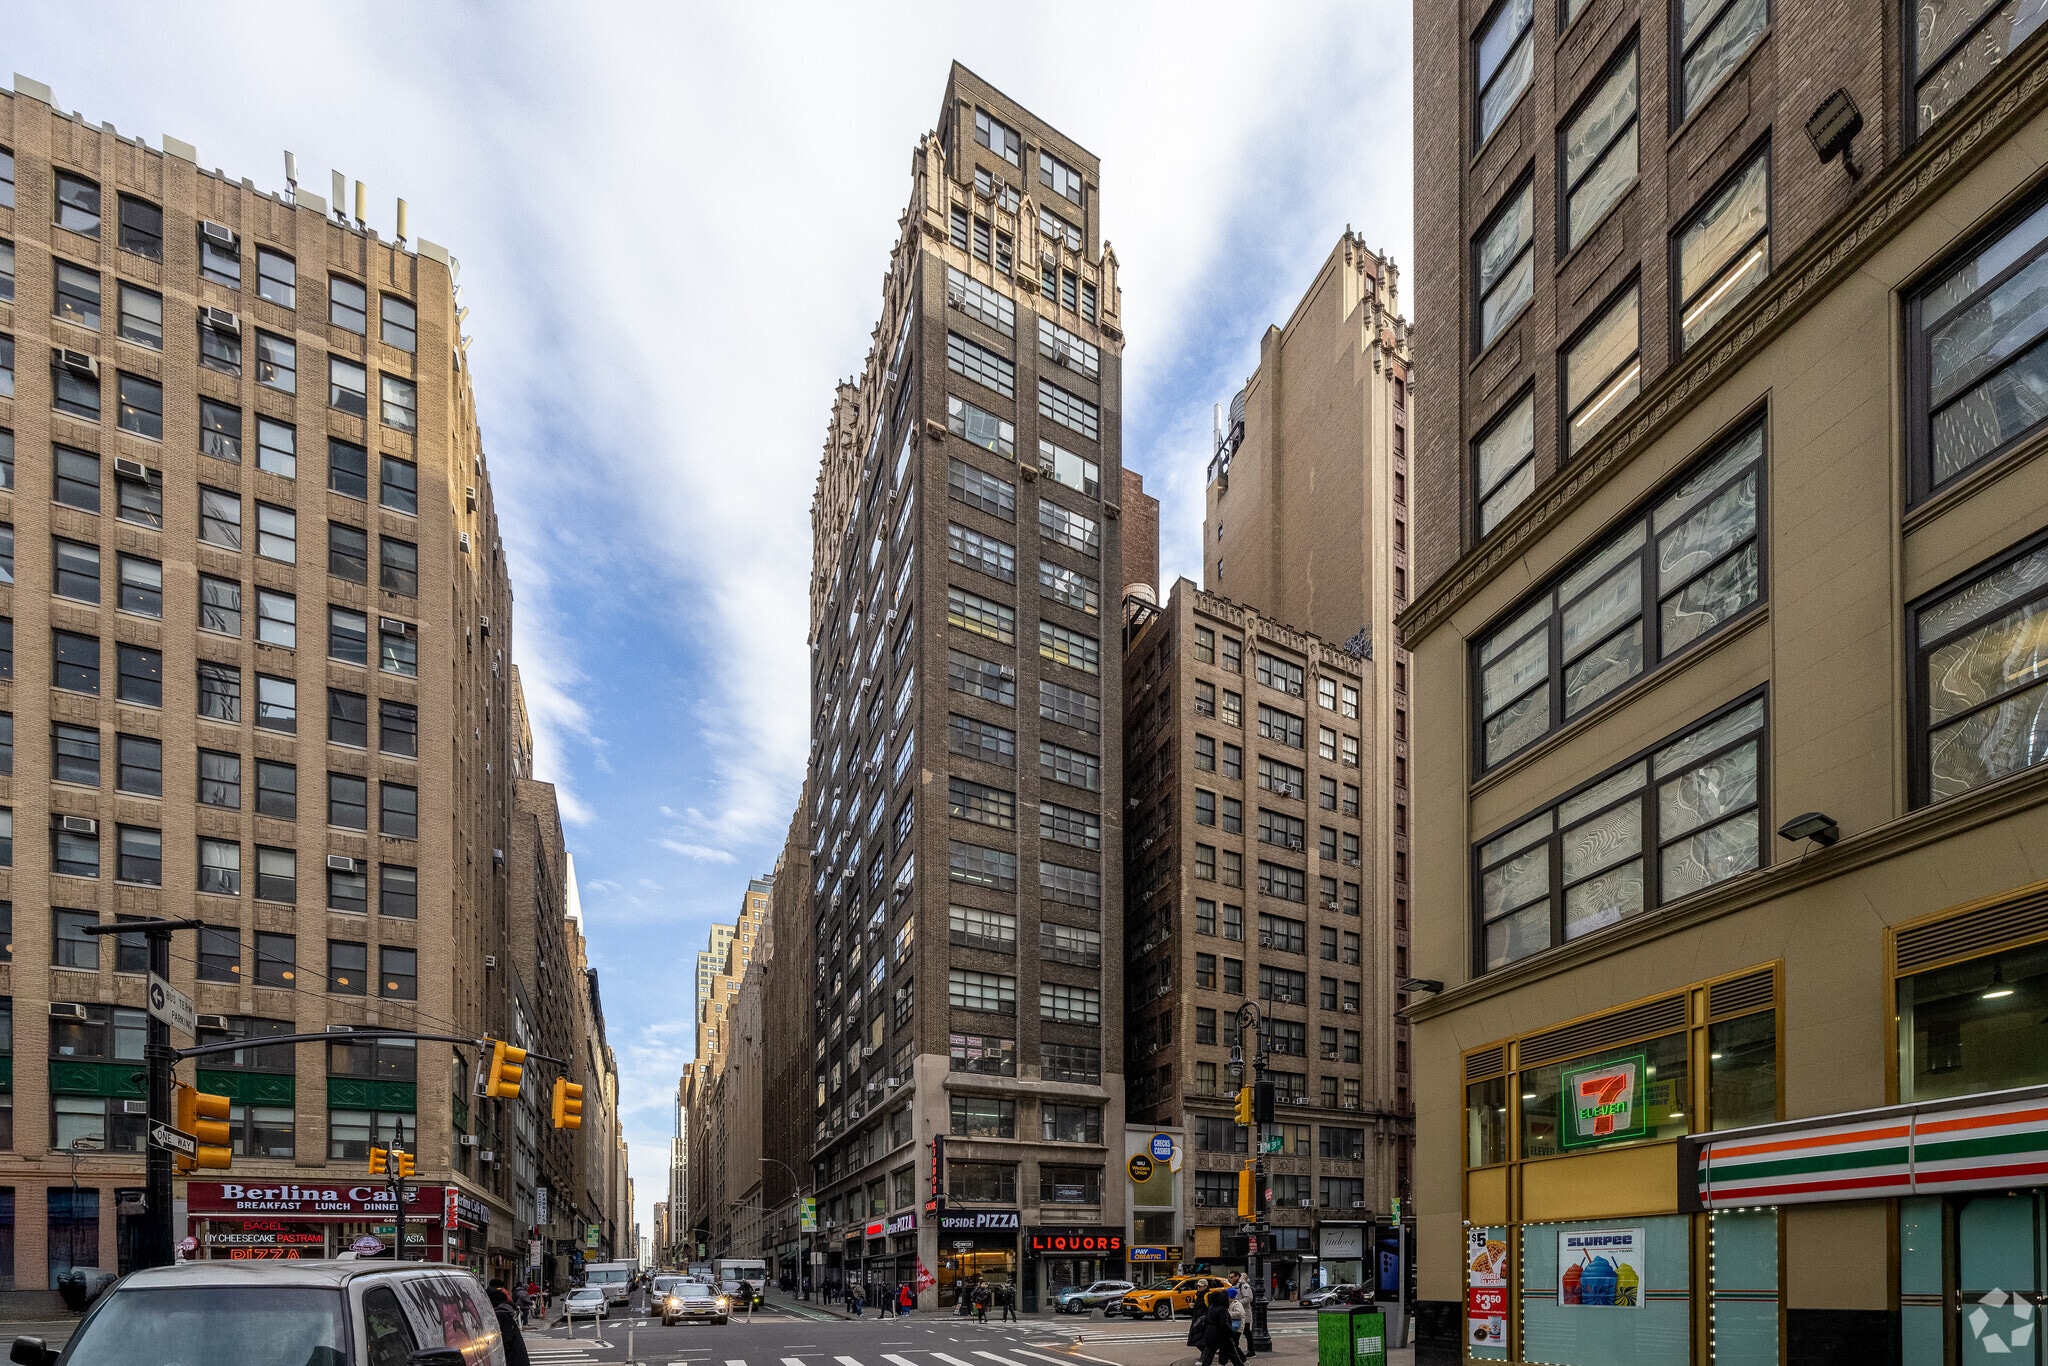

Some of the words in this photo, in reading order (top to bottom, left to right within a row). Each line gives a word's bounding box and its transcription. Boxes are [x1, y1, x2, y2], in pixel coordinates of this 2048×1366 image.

[166, 990, 176, 1004] BUS
[179, 999, 193, 1015] TERM
[171, 1010, 192, 1030] PARKING
[1580, 1074, 1627, 1136] 7
[157, 1130, 171, 1143] ONE
[177, 1138, 191, 1150] WAY
[1153, 1139, 1171, 1147] CHECKS
[1153, 1147, 1171, 1155] CASHED
[221, 1184, 339, 1202] Berlina
[236, 1201, 302, 1210] BREAKFAST
[315, 1202, 350, 1210] LUNCH
[447, 1188, 458, 1229] PIZZA
[243, 1222, 286, 1231] BAGEL
[897, 1214, 912, 1232] PIZZA
[942, 1217, 974, 1228] UPSIDE
[976, 1213, 1019, 1228] PIZZA
[218, 1233, 276, 1243] CHEESECAKE
[276, 1233, 323, 1243] PASTRAMI
[405, 1235, 425, 1243] ASTA
[1033, 1236, 1120, 1250] LIQUORS
[1471, 1232, 1486, 1247] $5
[1567, 1235, 1633, 1247] SLURPEE
[230, 1248, 301, 1260] PIZZA
